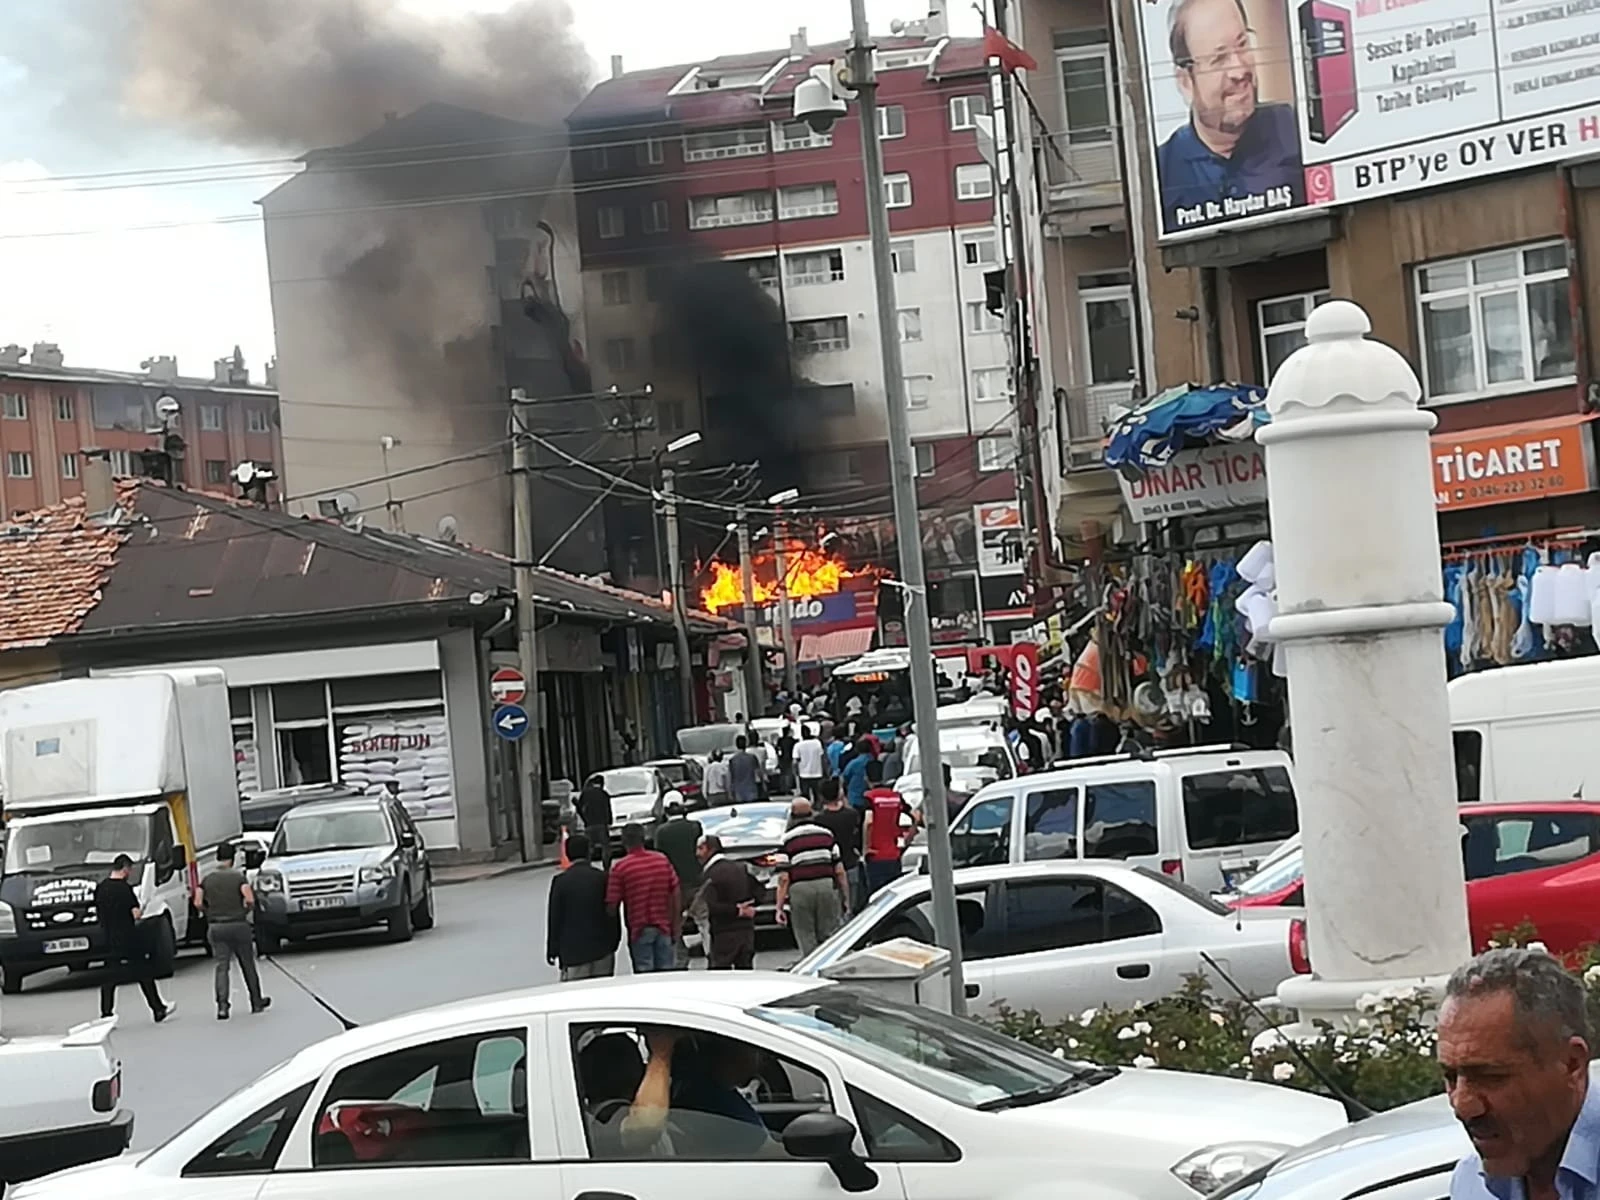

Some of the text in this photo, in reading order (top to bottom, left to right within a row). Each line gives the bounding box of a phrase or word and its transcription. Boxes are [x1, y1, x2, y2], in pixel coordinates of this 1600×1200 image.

[1366, 36, 1402, 61] Sessiz
[1406, 30, 1422, 52] Bir
[1426, 18, 1477, 47] Devrimle
[1391, 49, 1457, 84] Kapitalizmi
[1376, 91, 1412, 113] Tarihe
[1355, 152, 1448, 188] BTP'ye
[1459, 136, 1496, 166] OY
[1506, 123, 1567, 155] VER
[1176, 186, 1292, 226] Prof. Dr. Haydar BAŞ
[1436, 438, 1561, 484] TİCARET
